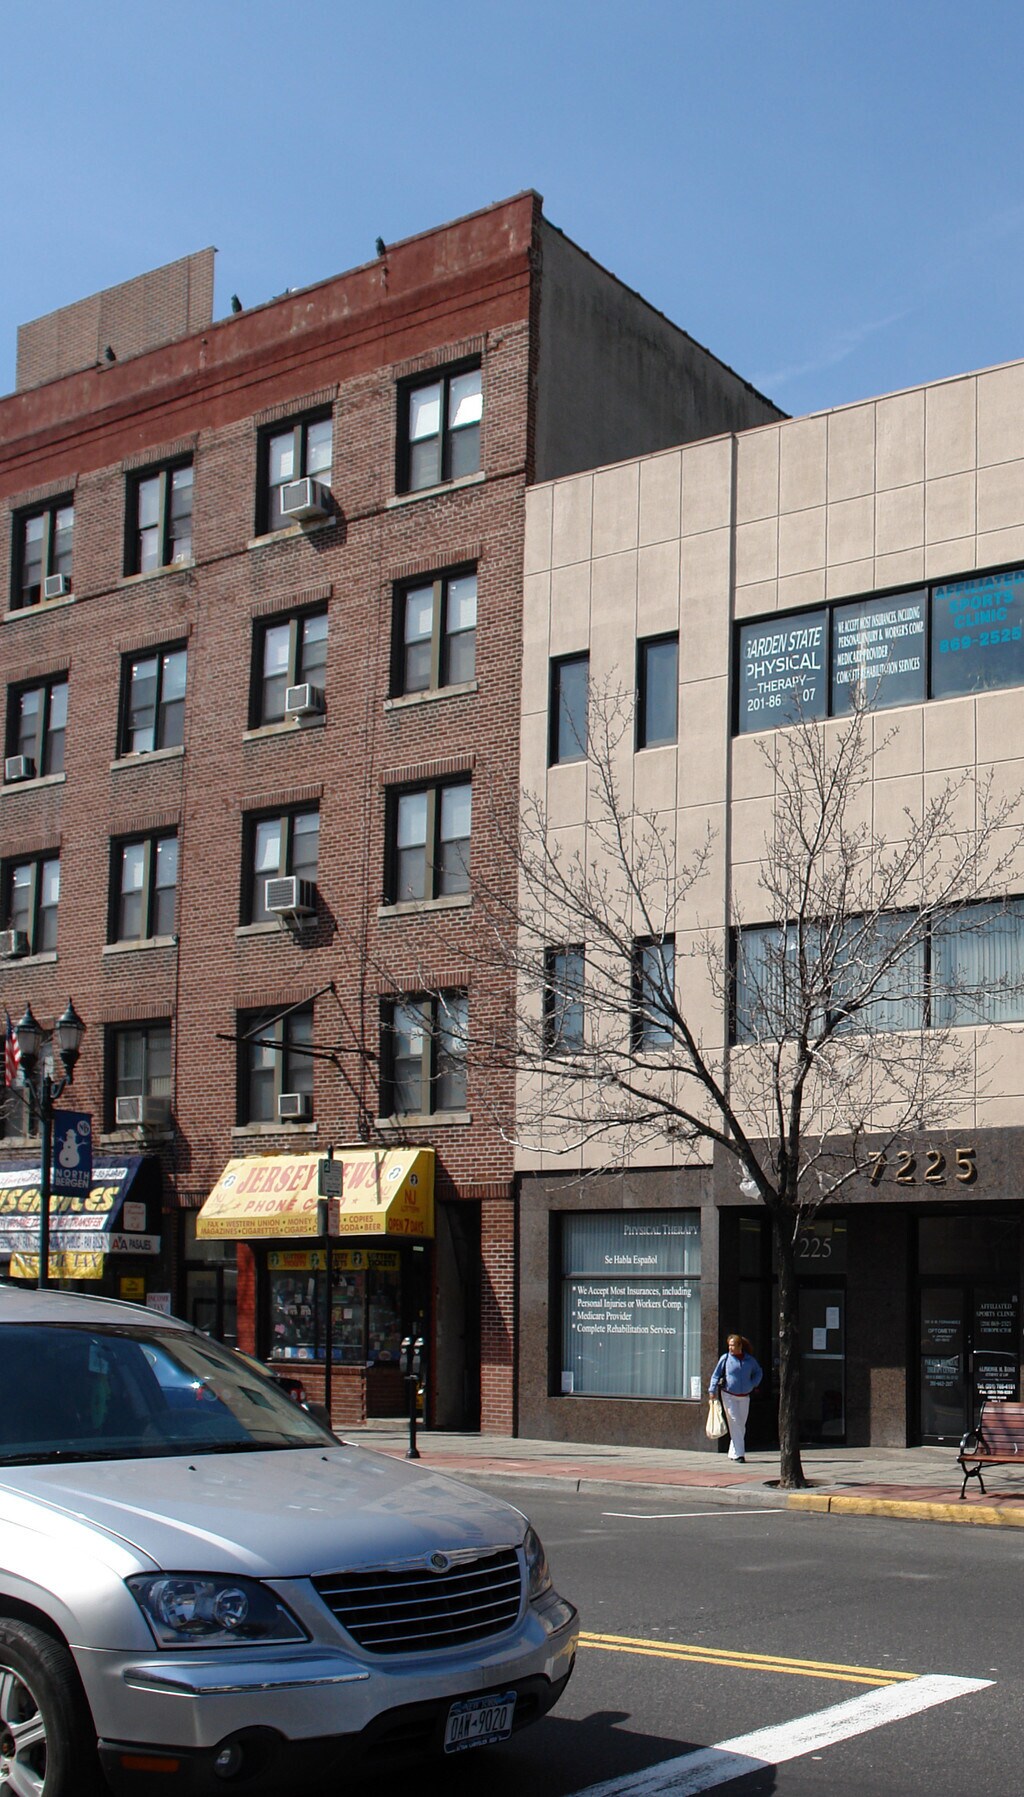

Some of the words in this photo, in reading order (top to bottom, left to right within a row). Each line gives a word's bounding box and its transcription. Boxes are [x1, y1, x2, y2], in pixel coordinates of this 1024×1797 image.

[935, 571, 1024, 599] AFFILIATED
[949, 589, 1014, 614] SPORTS
[954, 607, 1007, 629] CLINIC
[788, 626, 822, 651] STATE
[940, 627, 1021, 653] 869-2525
[746, 651, 821, 681] PHYSICAL
[757, 674, 807, 694] THERAPY
[868, 1148, 974, 1183] 7225
[56, 1169, 90, 1180] NORTH
[236, 1164, 318, 1194] JERSEY
[341, 1162, 386, 1189] EWS
[55, 1177, 89, 1189] BERGEN
[244, 1199, 297, 1213] PHONE
[71, 1216, 104, 1227] TRANSFER
[288, 1217, 311, 1225] MONEY
[349, 1215, 373, 1223] COPIES
[201, 1227, 237, 1235] MAGAZINES
[242, 1226, 279, 1235] CIGARETTES
[284, 1225, 308, 1233] CIGARS
[340, 1223, 359, 1231] SODA
[364, 1222, 381, 1231] BEER
[404, 1218, 410, 1233] 7
[129, 1239, 151, 1250] PASAJES
[73, 1254, 99, 1267] TAX
[605, 1256, 613, 1264] Se
[614, 1255, 632, 1264] Habla
[633, 1254, 658, 1266] Español
[577, 1286, 587, 1295] We
[587, 1286, 609, 1297] Accept
[610, 1286, 626, 1295] Most
[627, 1286, 661, 1297] Insurances,
[662, 1286, 692, 1298] including
[577, 1299, 603, 1308] Personal
[604, 1299, 626, 1310] Injuries
[635, 1299, 662, 1309] Workers
[662, 1299, 684, 1311] Comp.
[577, 1311, 605, 1320] Medicare
[606, 1311, 632, 1321] Provider
[577, 1323, 606, 1335] Complete
[606, 1323, 649, 1335] Rehabilitation
[650, 1325, 676, 1335] Services
